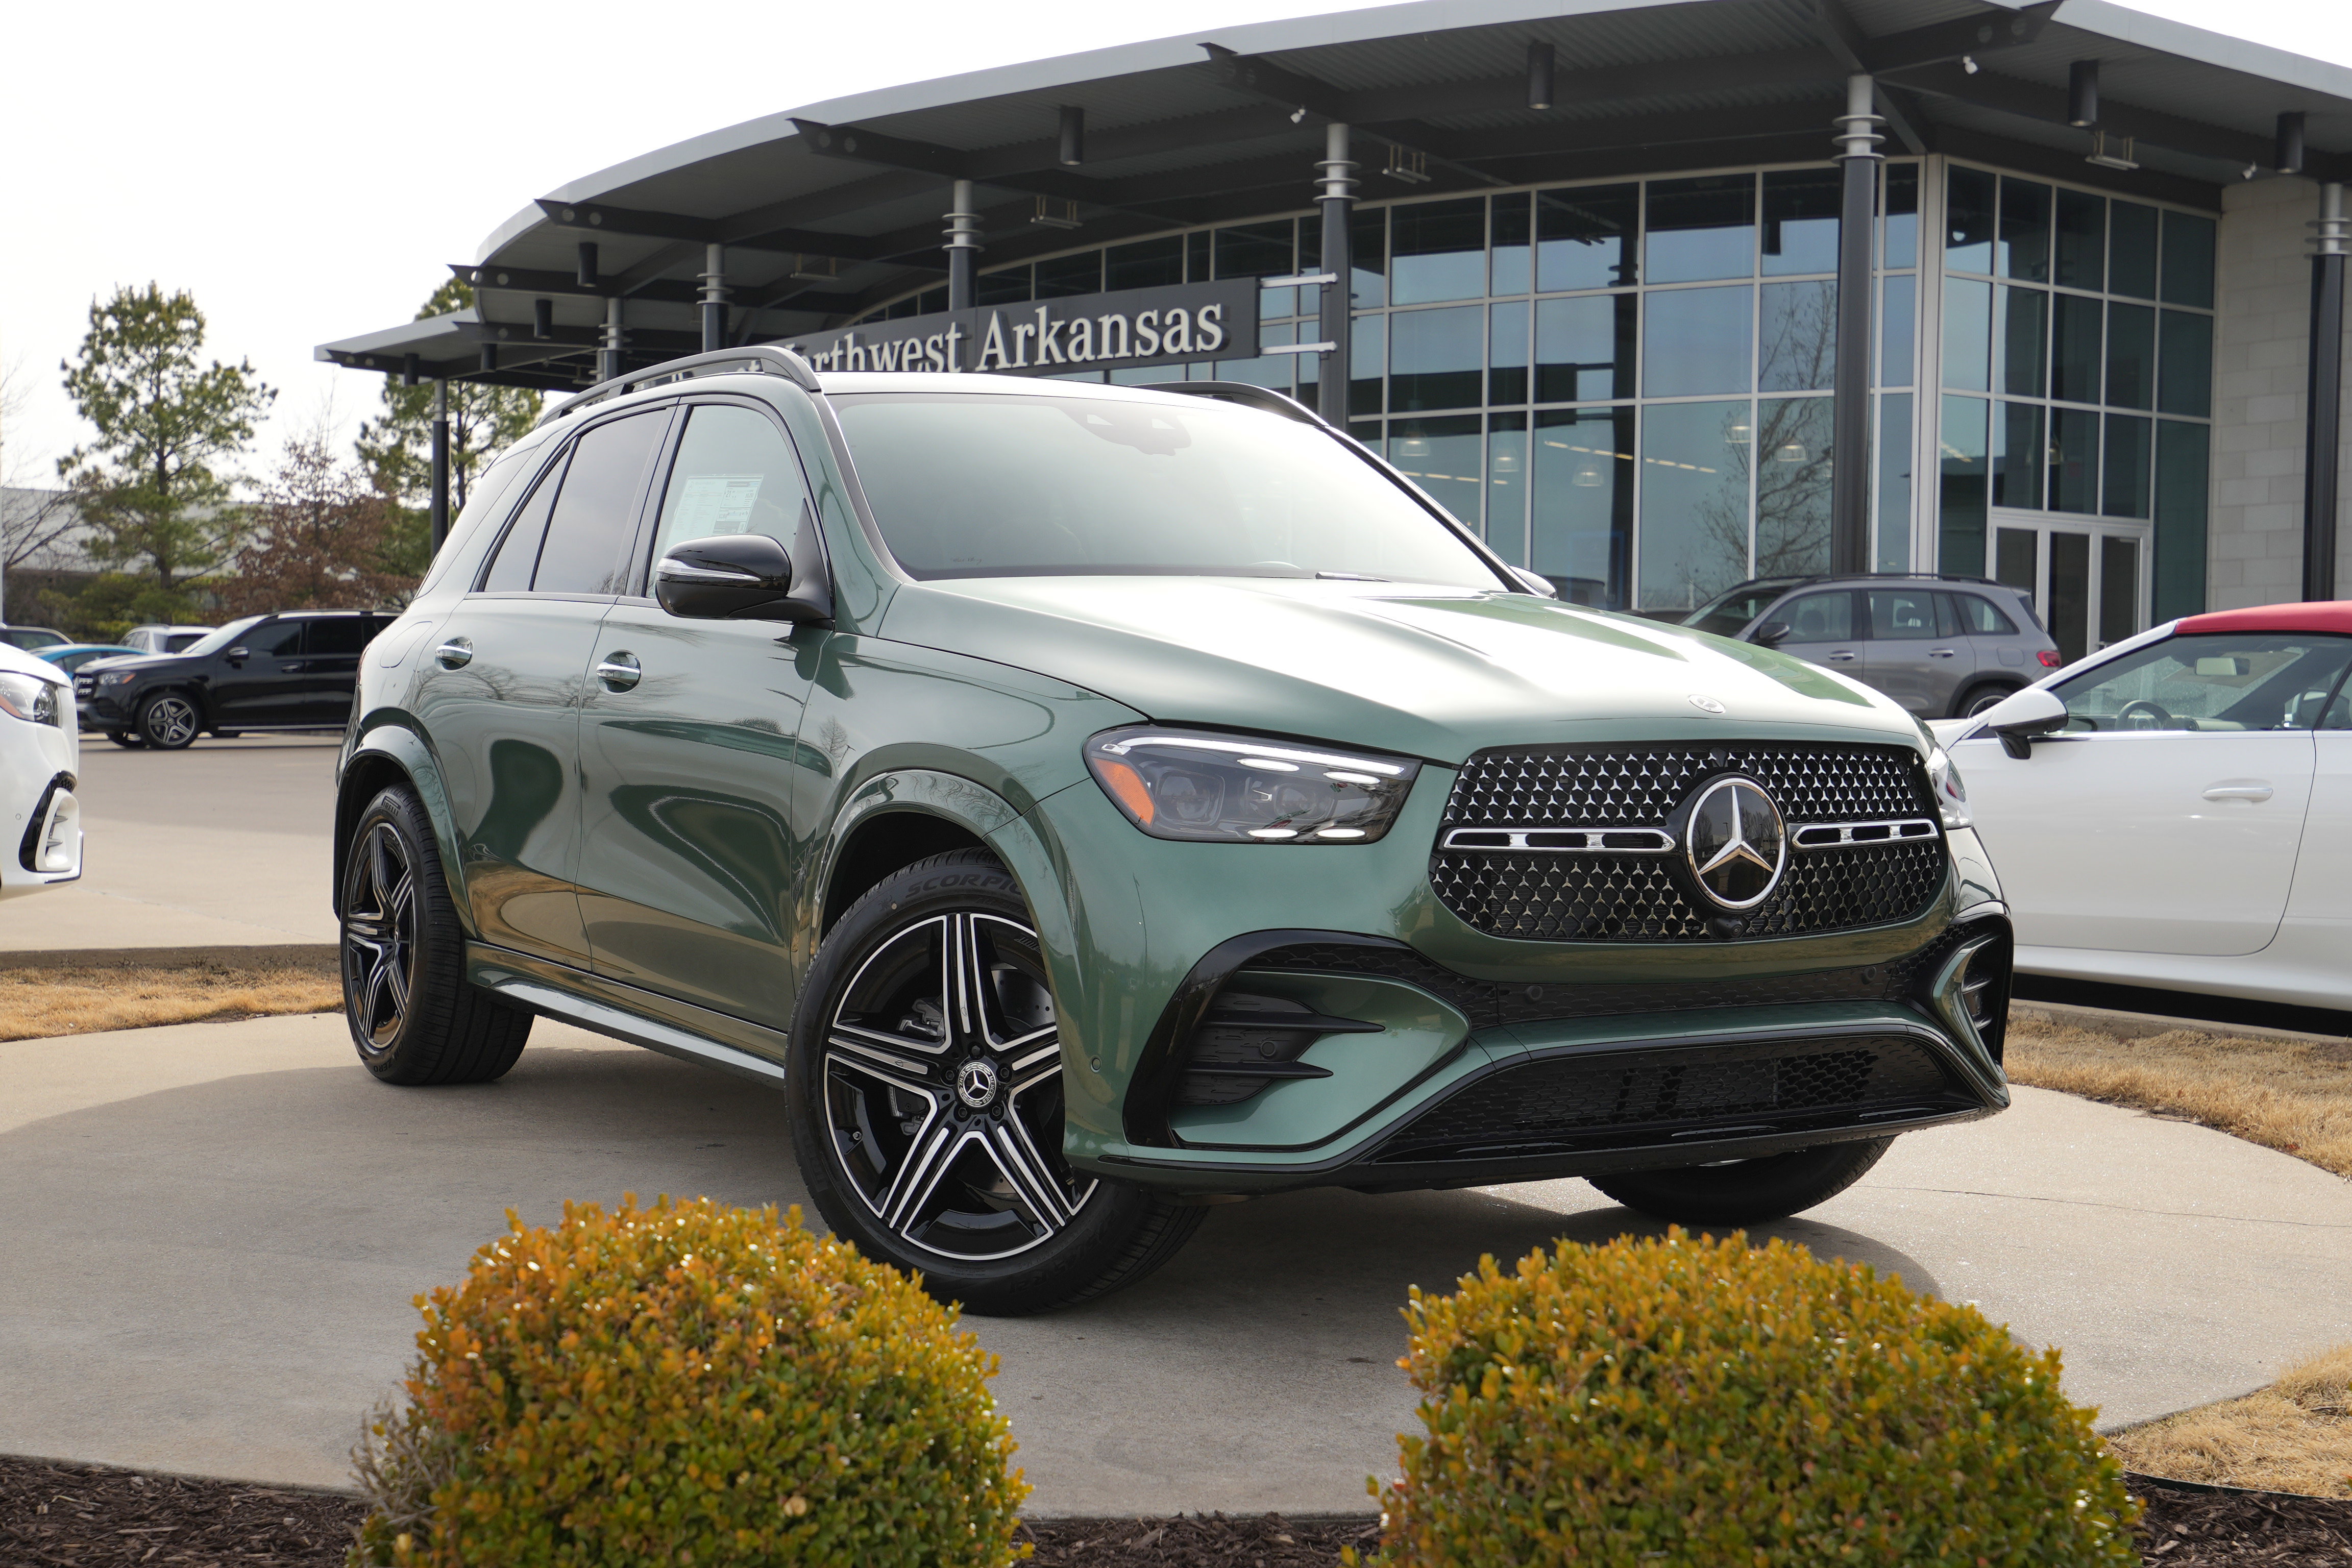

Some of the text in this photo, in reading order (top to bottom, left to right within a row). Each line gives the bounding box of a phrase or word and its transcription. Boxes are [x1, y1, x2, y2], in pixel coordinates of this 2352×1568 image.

[784, 304, 1223, 373] rthwest Arkansas
[381, 796, 401, 816] PIRELLI
[983, 1075, 995, 1104] MERCEDES
